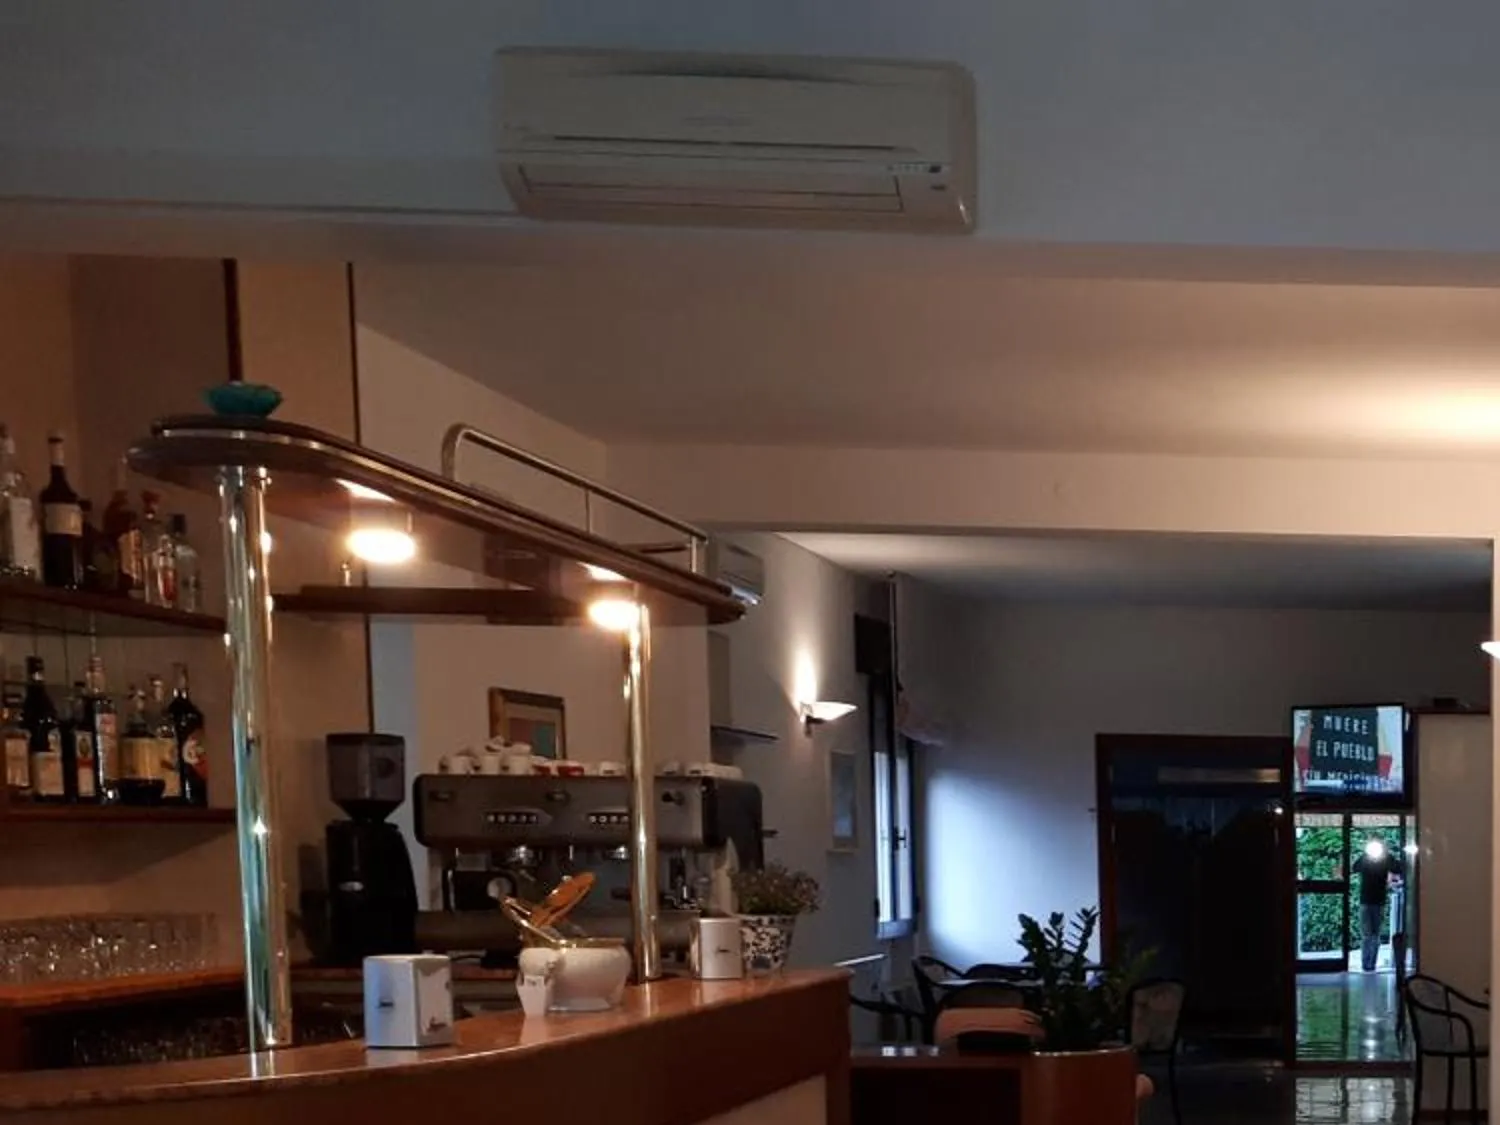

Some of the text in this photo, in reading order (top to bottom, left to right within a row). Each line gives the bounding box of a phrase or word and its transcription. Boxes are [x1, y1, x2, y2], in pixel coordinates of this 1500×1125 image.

[1323, 715, 1368, 735] MUERE
[1316, 740, 1375, 761] EL PUEBLO
